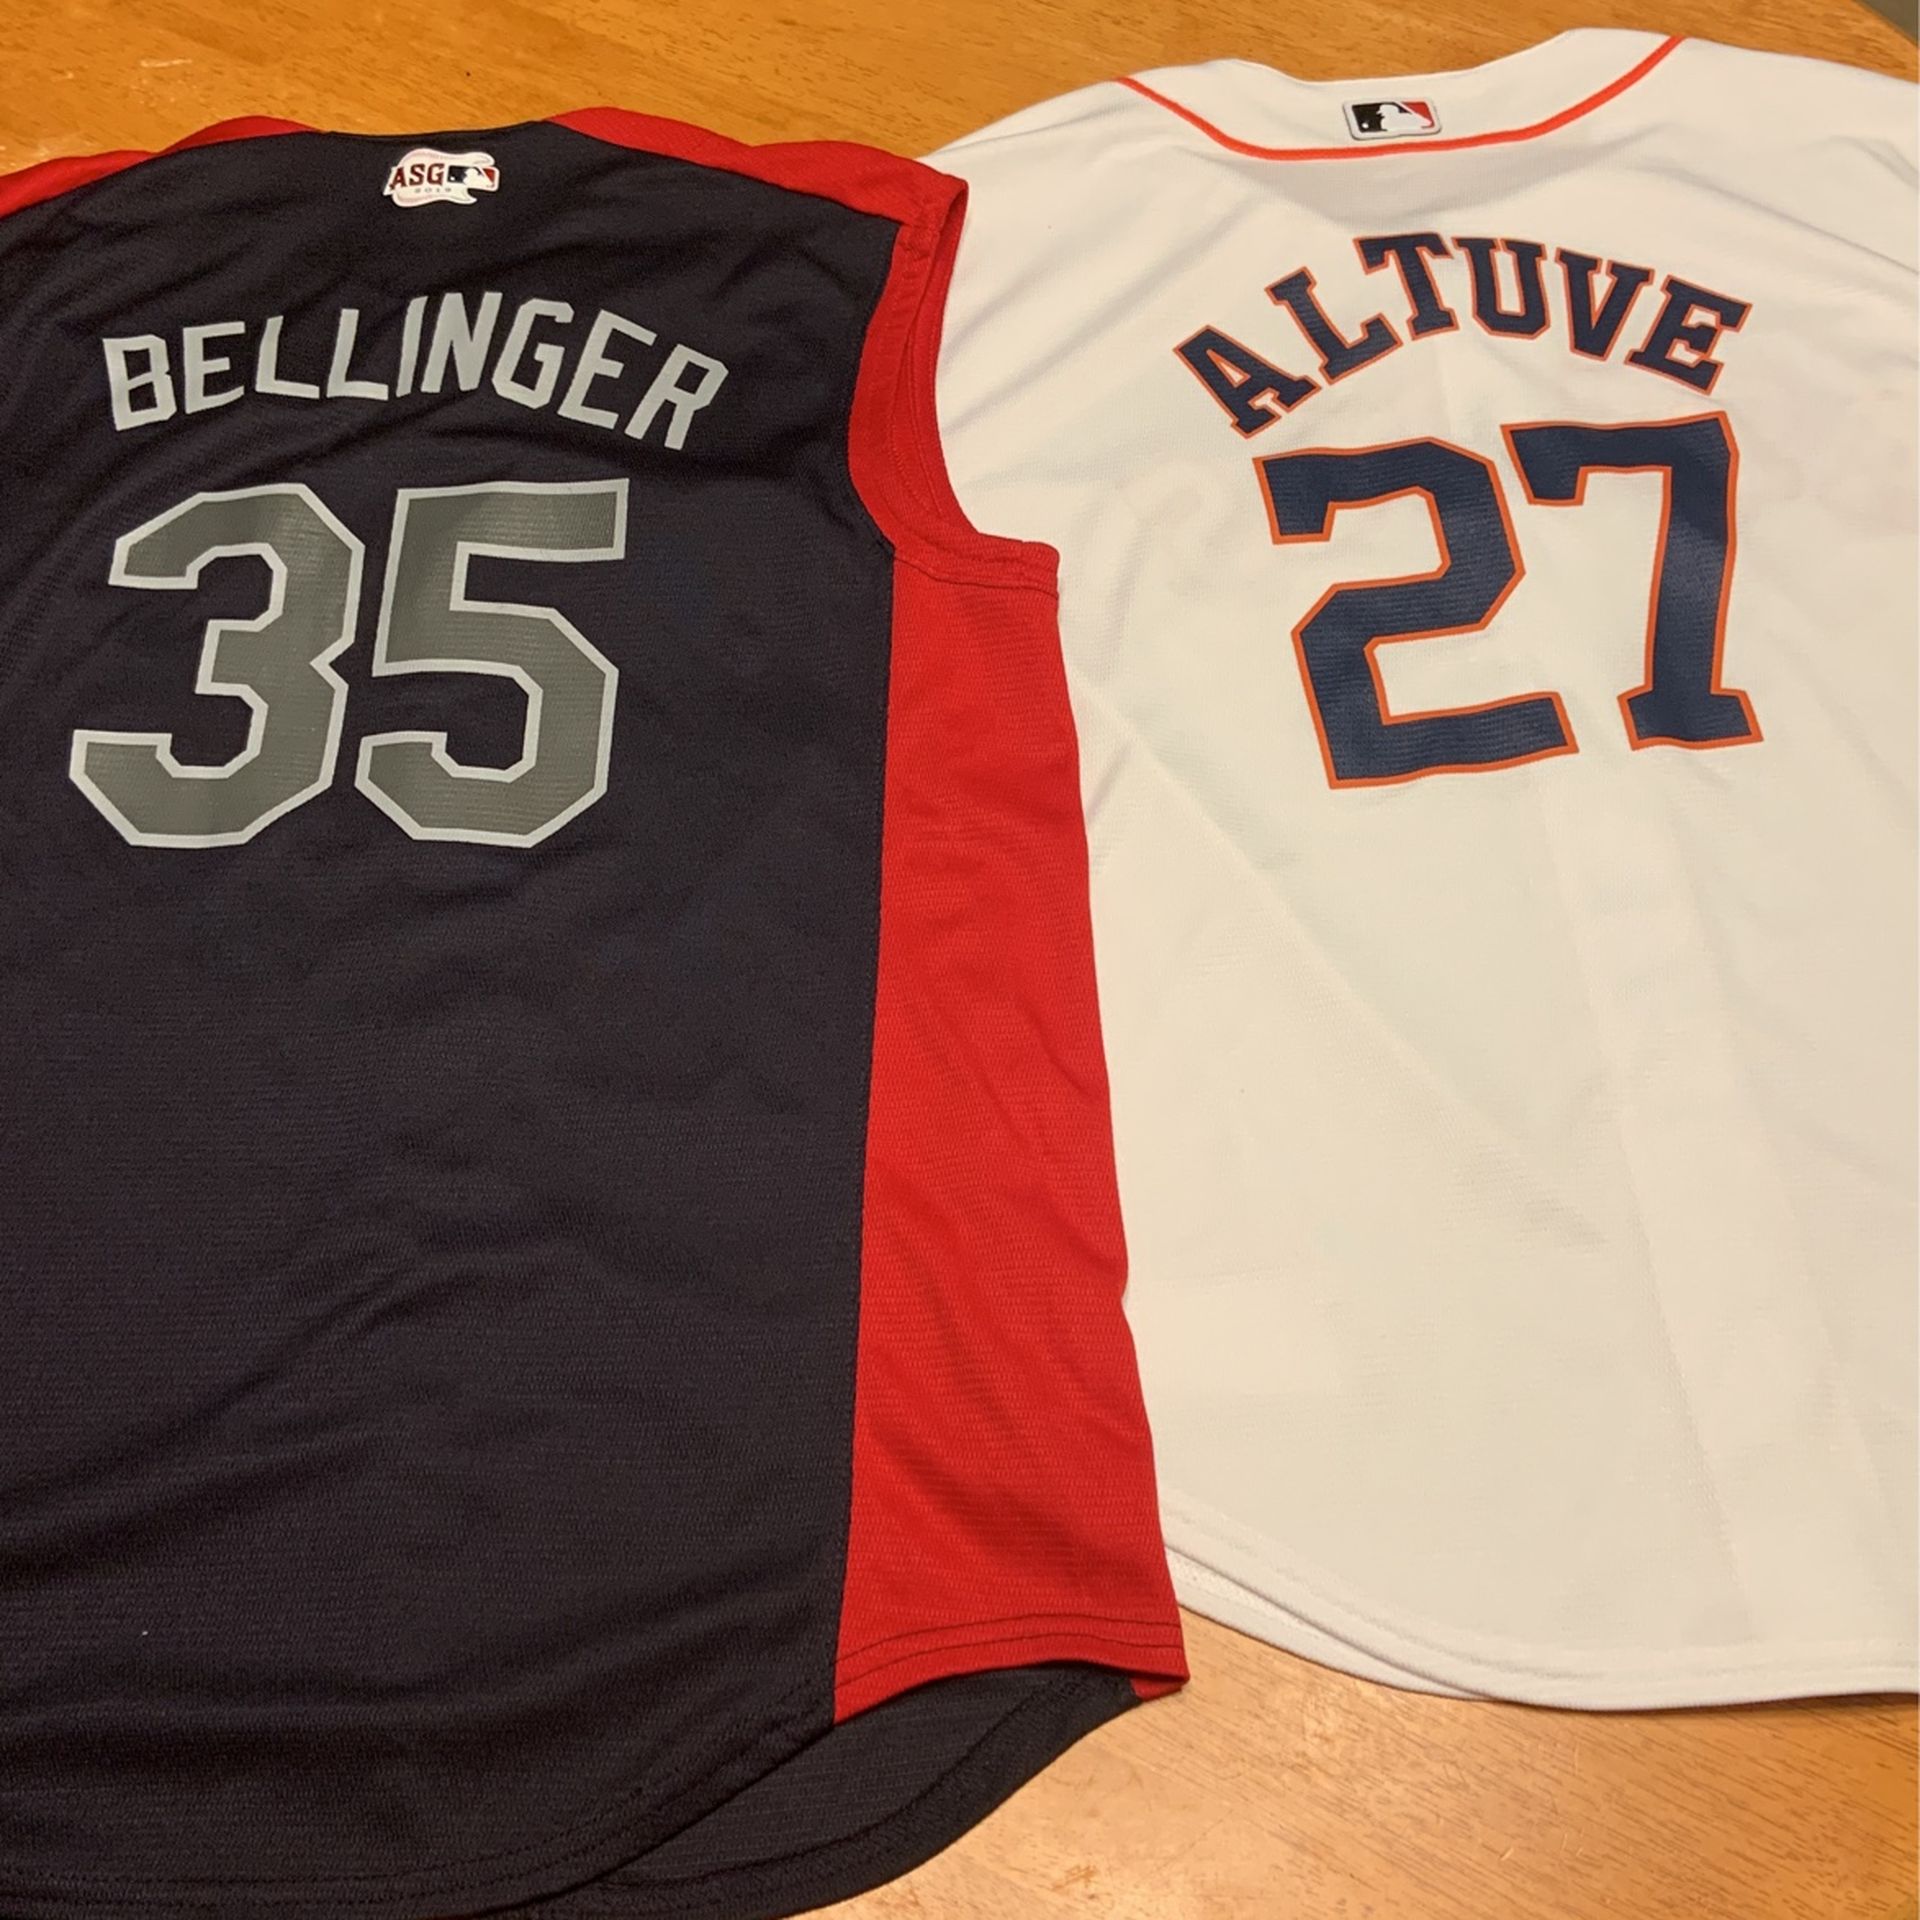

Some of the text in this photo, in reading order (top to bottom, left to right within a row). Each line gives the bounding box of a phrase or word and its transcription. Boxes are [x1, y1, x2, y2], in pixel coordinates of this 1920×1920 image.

[389, 163, 445, 190] ASG
[103, 290, 729, 452] BELLINGER
[1174, 232, 1752, 439] ALTUVE
[69, 477, 629, 848] 35
[1253, 411, 1764, 788] 27
